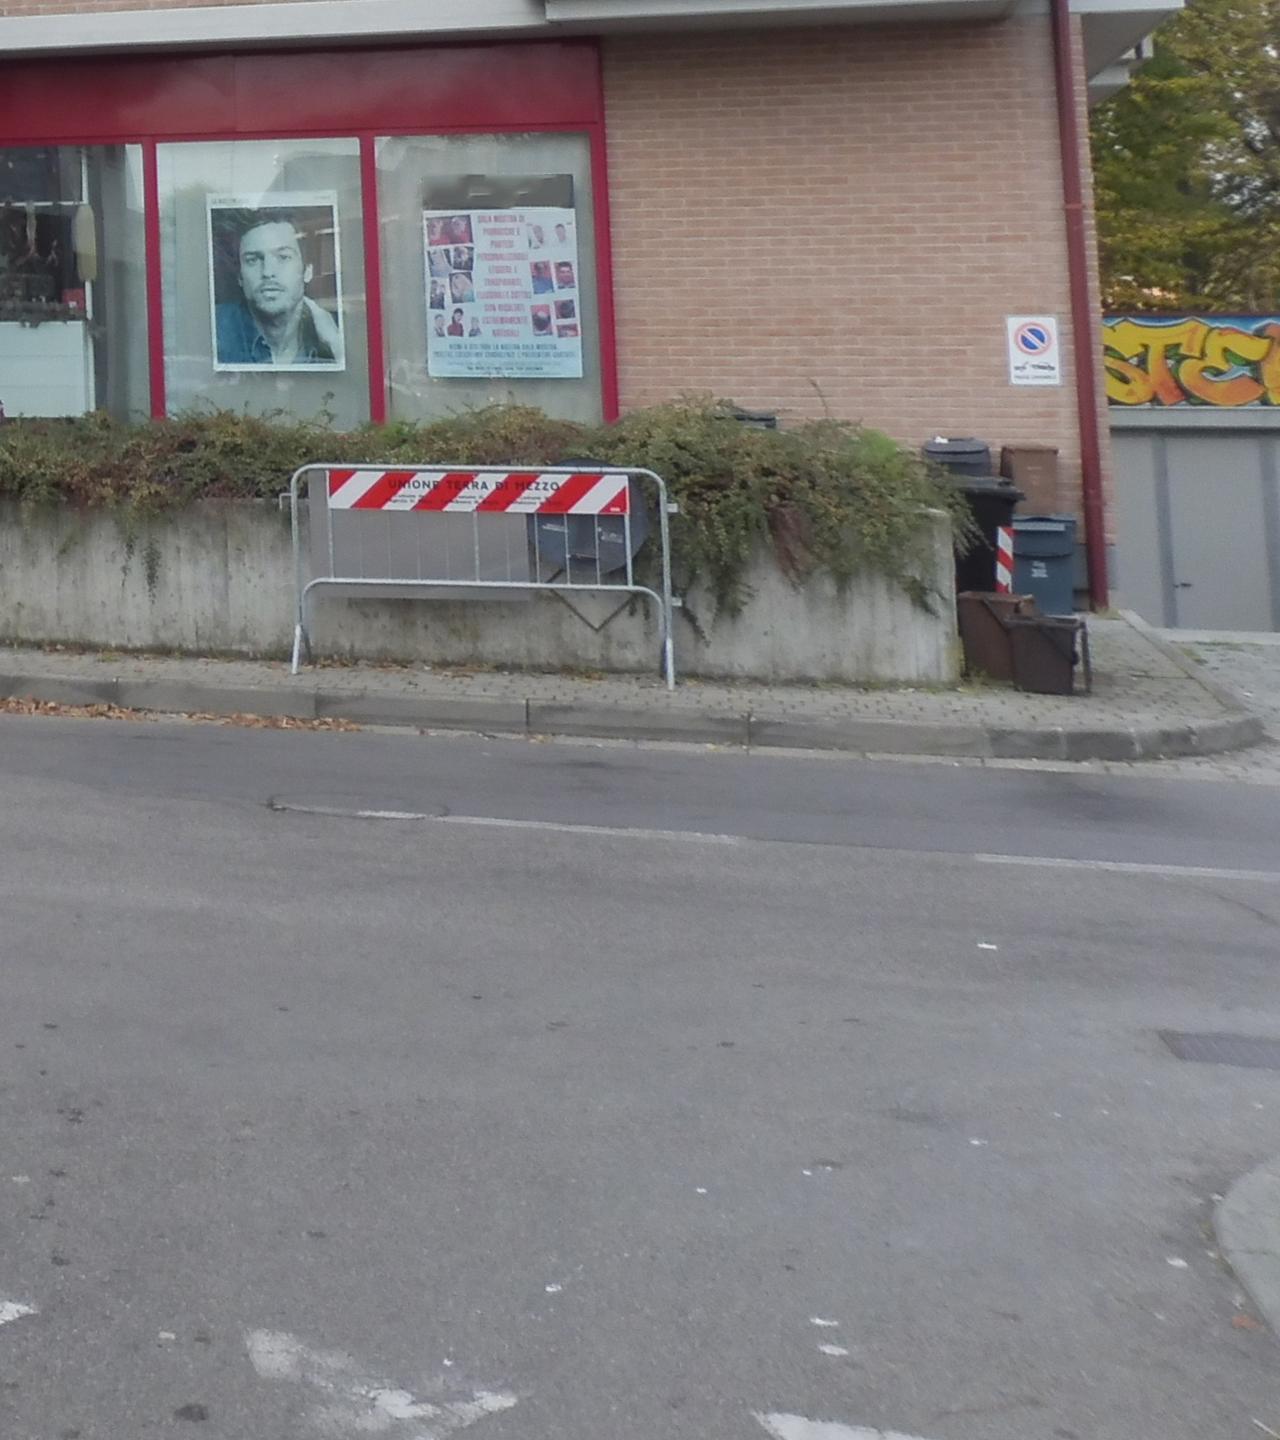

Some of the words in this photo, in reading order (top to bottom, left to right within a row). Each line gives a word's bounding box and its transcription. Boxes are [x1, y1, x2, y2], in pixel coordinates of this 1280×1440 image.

[388, 479, 439, 490] UNIONE
[446, 479, 489, 490] TERRA
[495, 481, 510, 491] DI
[515, 481, 561, 492] MEZZO
